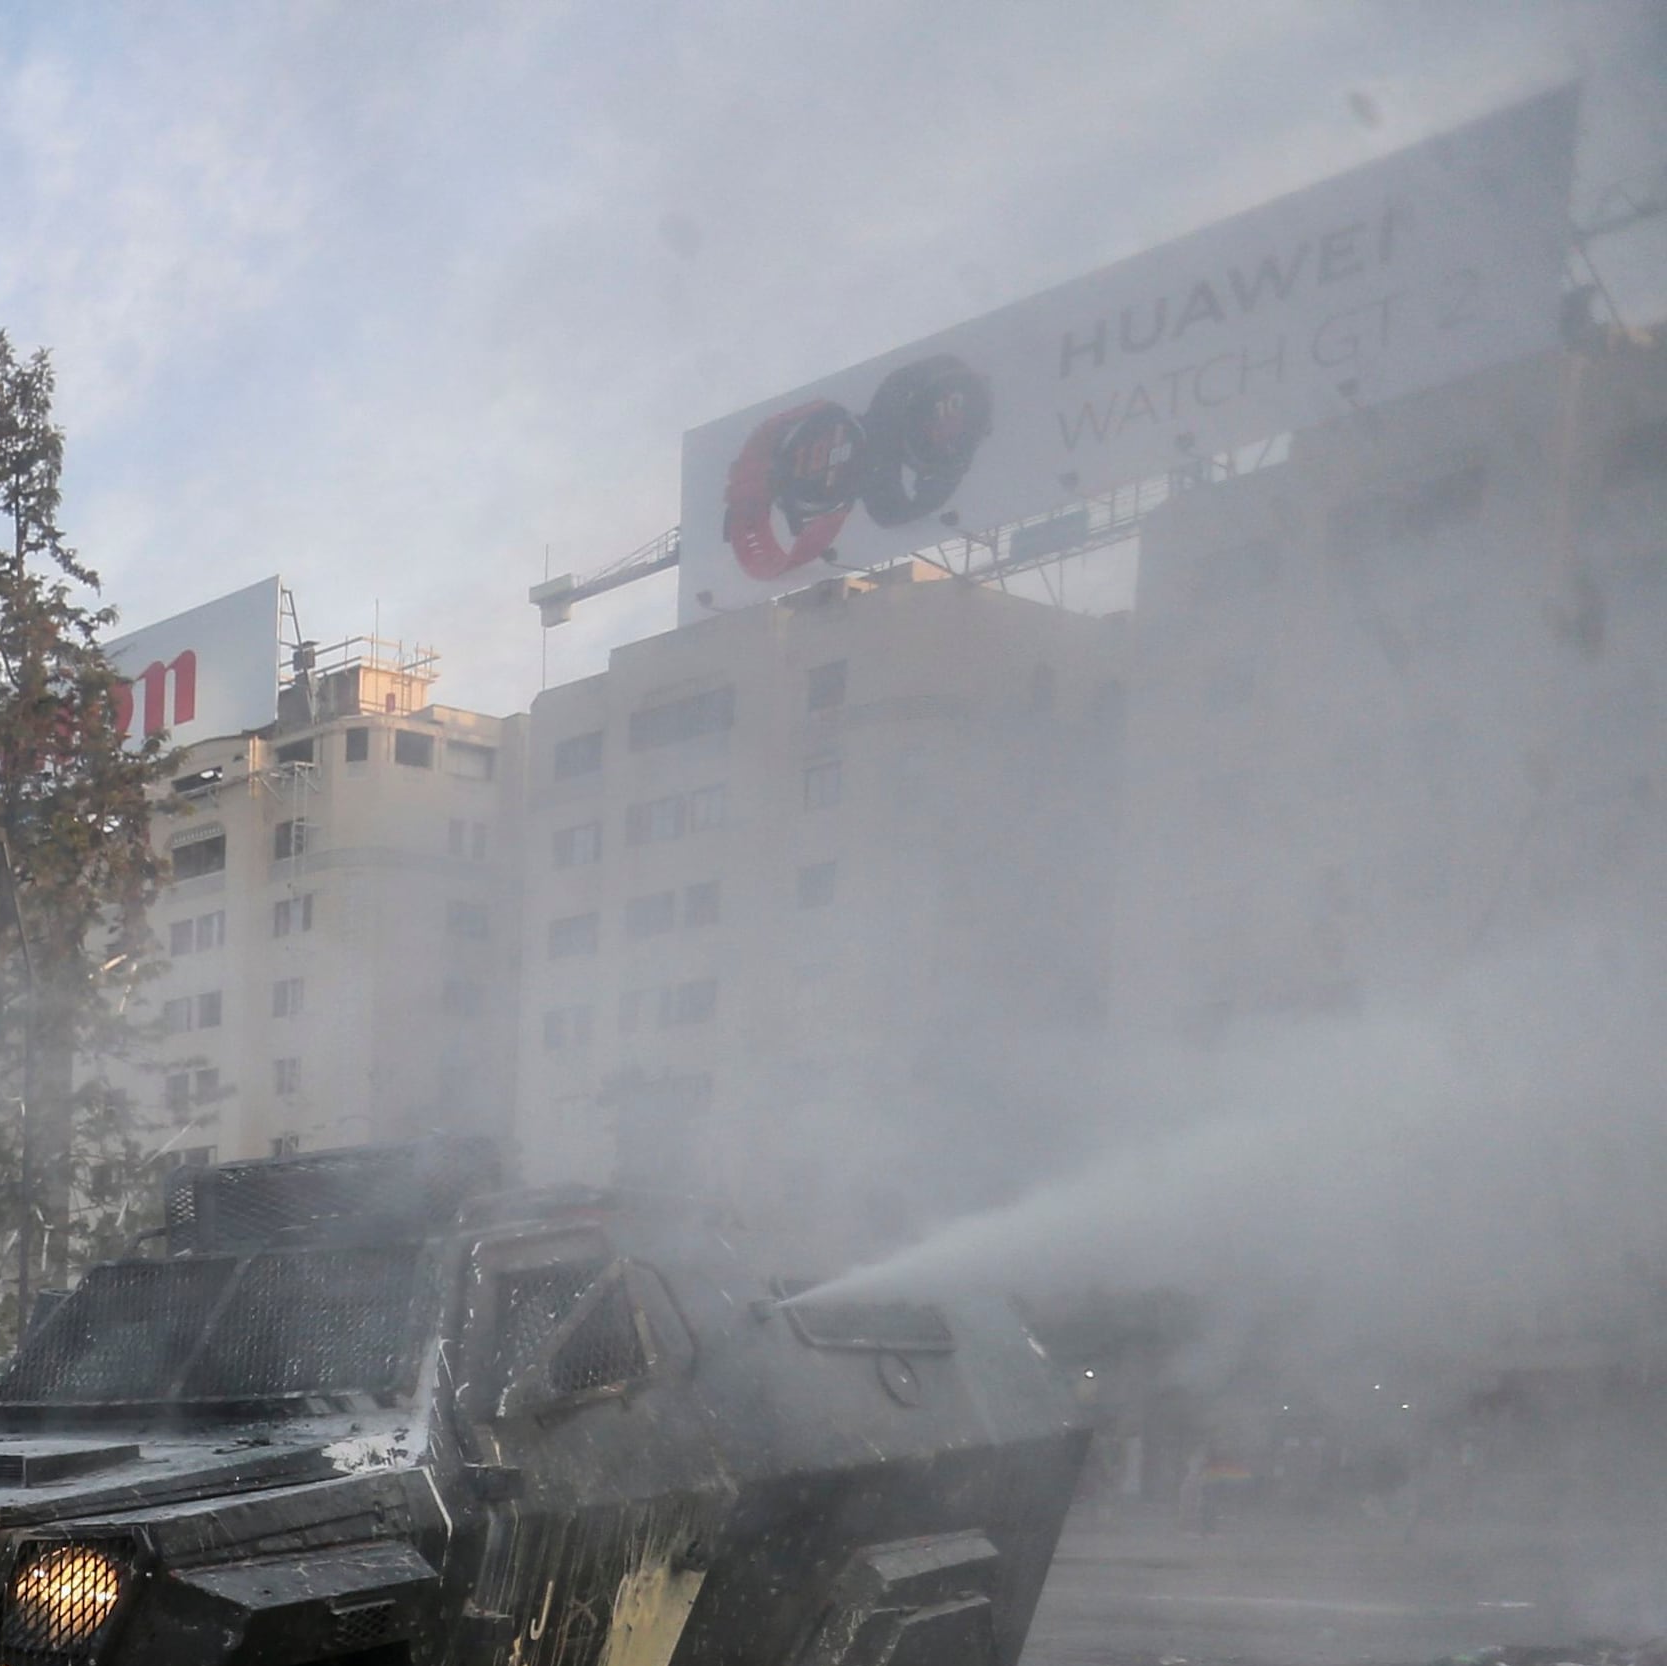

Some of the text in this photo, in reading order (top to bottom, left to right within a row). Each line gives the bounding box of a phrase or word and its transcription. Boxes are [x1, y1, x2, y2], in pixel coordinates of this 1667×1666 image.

[1056, 333, 1287, 452] WATCH
[1309, 290, 1407, 368] GT
[1059, 201, 1397, 379] HUAWEI
